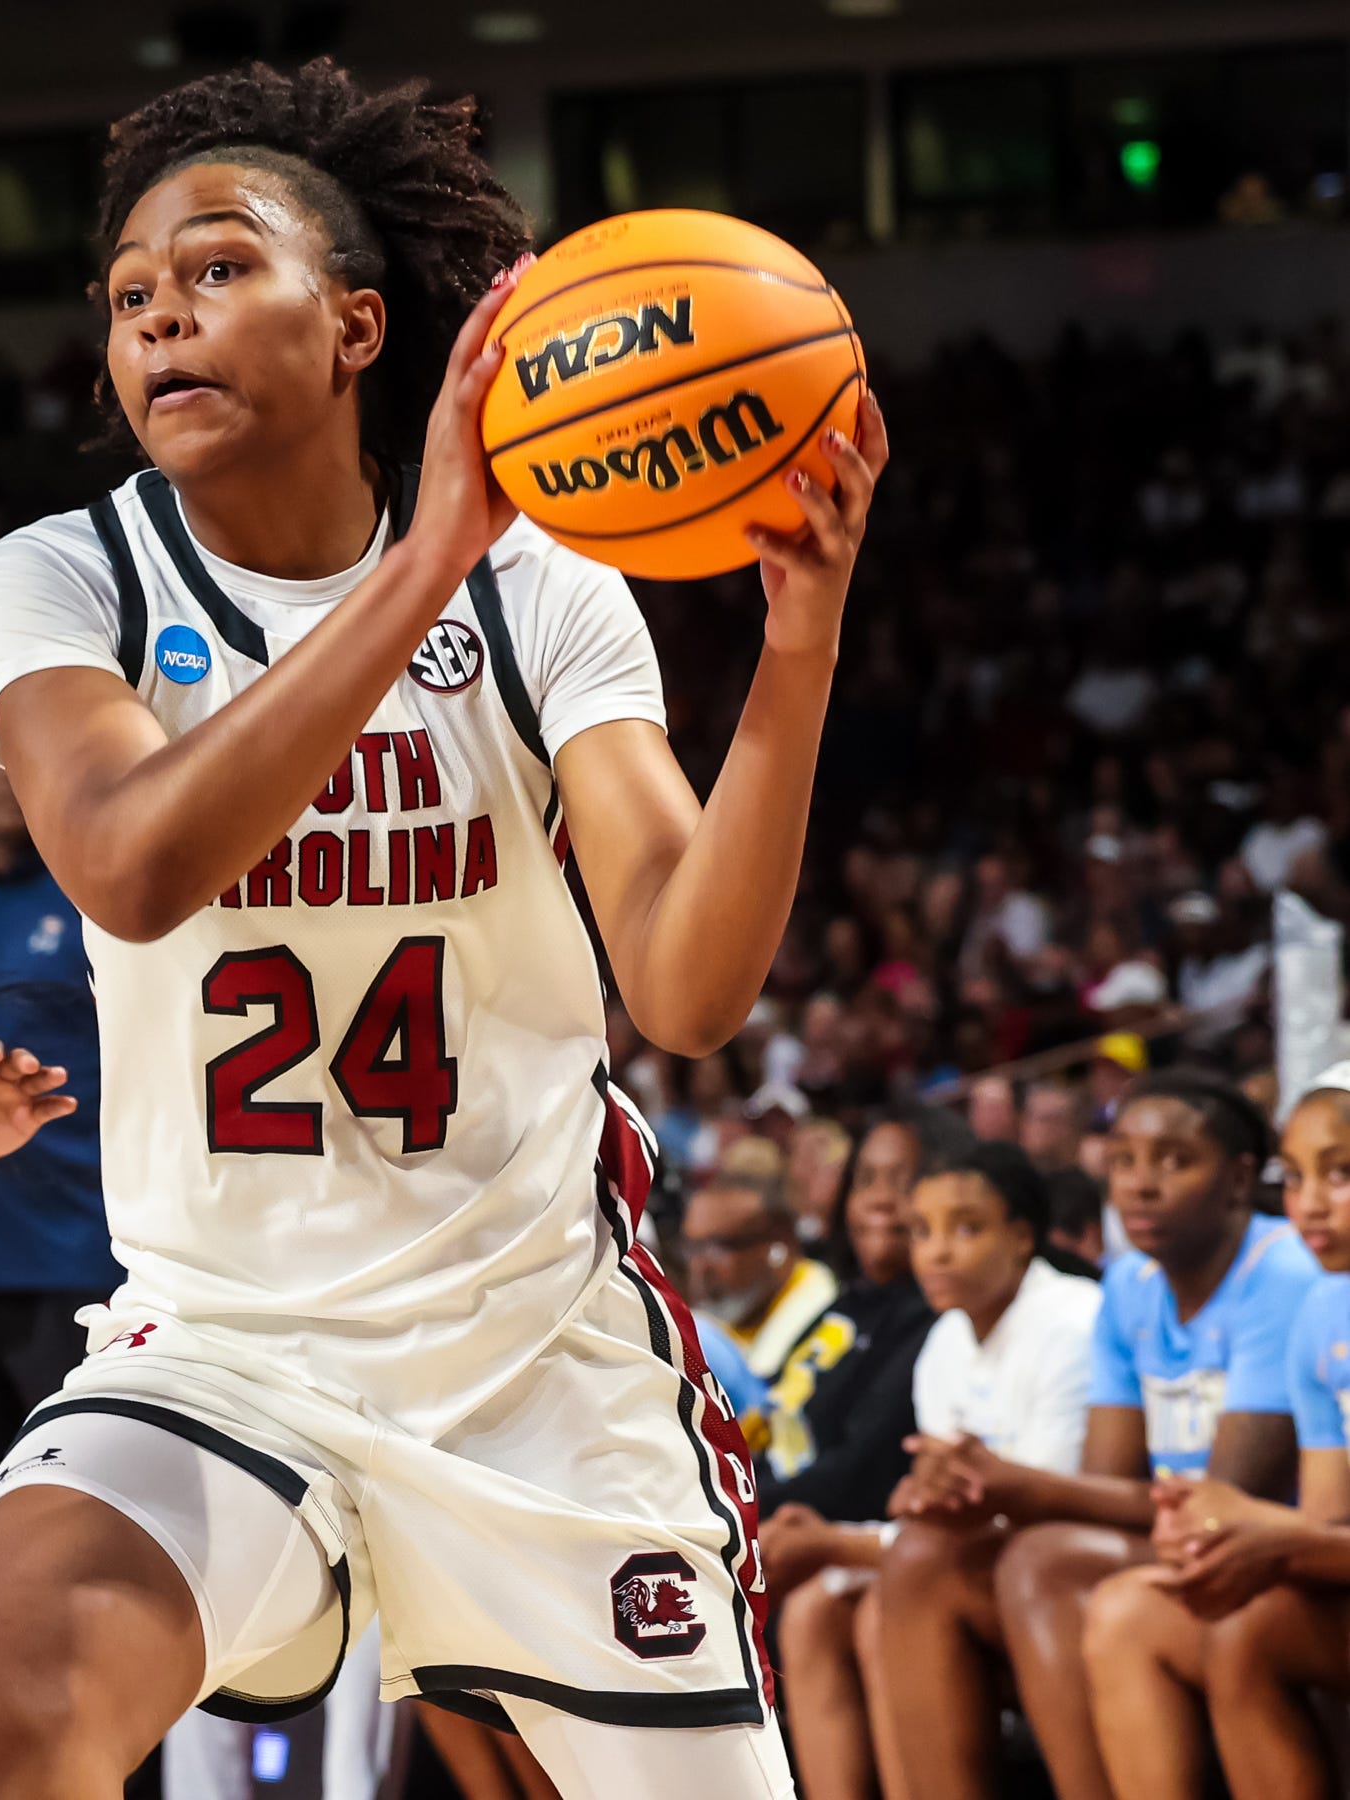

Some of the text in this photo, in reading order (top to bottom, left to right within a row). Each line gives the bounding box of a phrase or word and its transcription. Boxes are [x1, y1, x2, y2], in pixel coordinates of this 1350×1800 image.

[516, 295, 694, 402] NCAA
[528, 389, 784, 496] Wilson
[162, 648, 208, 671] NCAA
[412, 623, 479, 688] SEC
[310, 728, 442, 815] UTH
[207, 813, 499, 909] ROLINA
[201, 935, 459, 1157] 24
